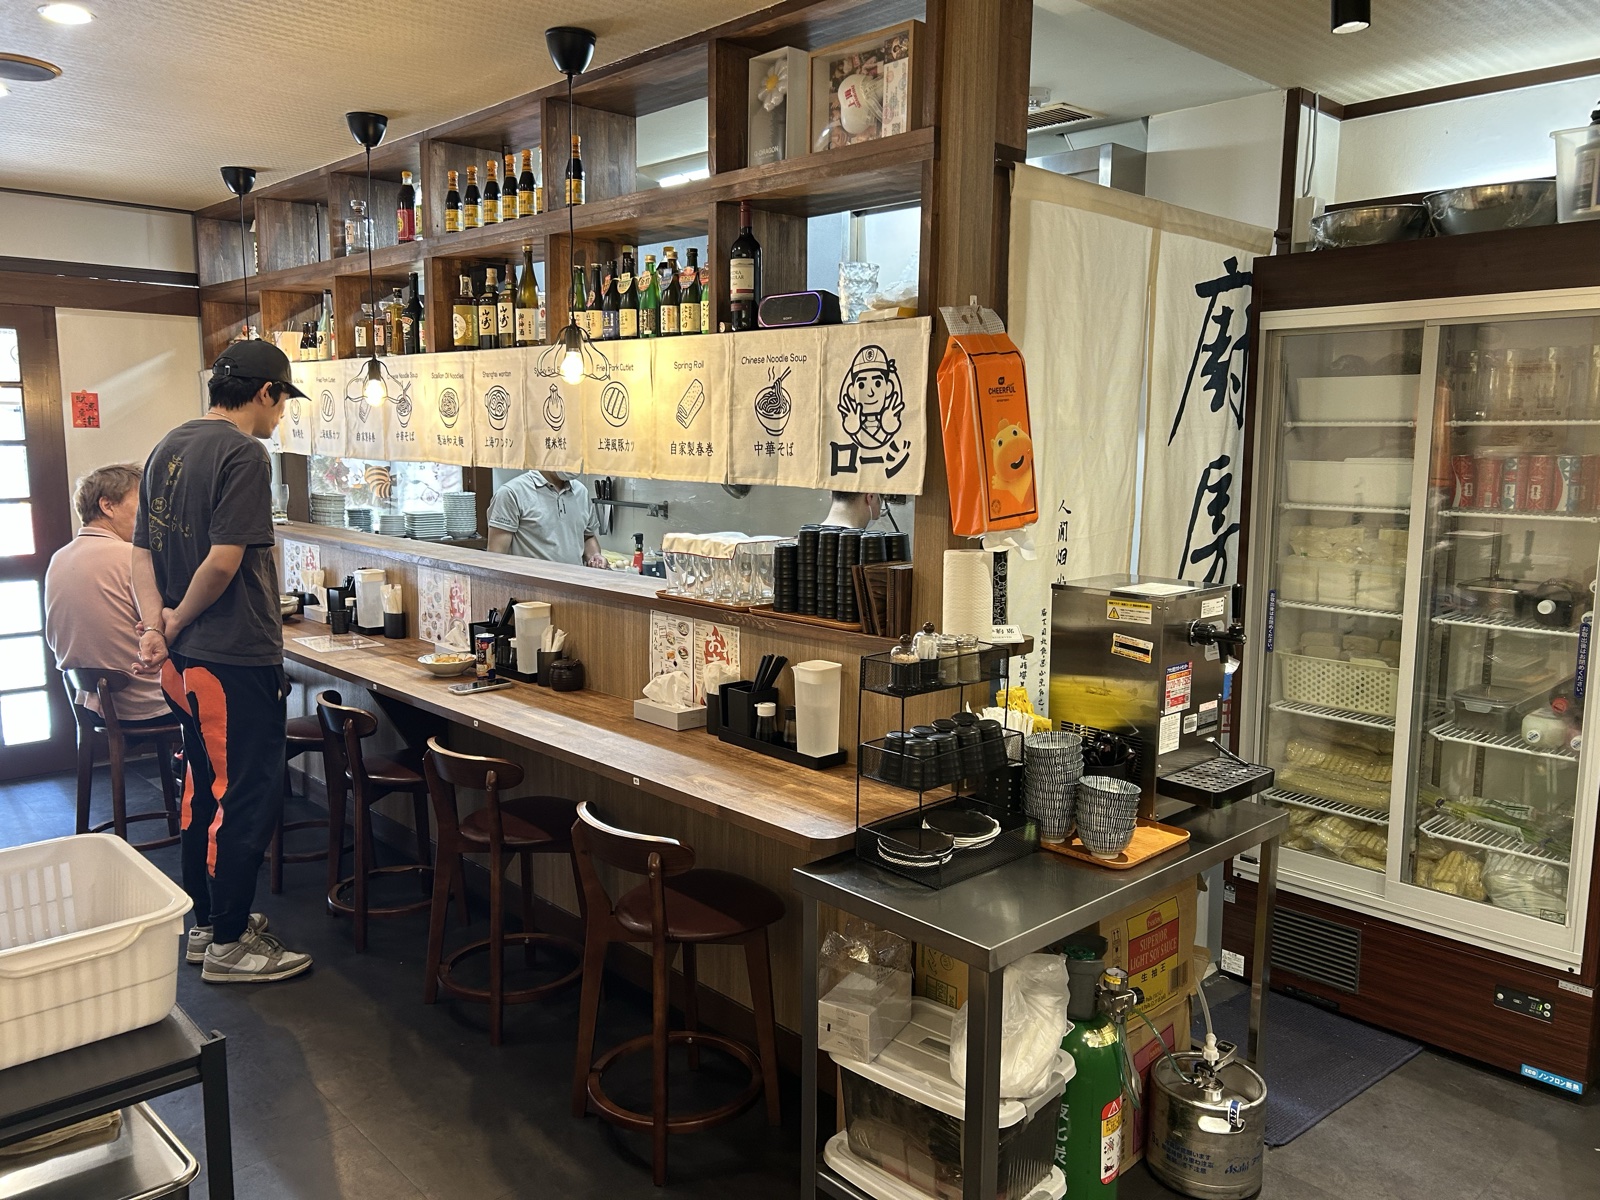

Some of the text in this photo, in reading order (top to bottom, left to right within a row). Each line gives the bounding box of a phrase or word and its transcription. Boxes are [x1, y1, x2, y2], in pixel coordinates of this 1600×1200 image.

[673, 360, 705, 371] Spring Roll
[741, 352, 807, 365] Chinese Noodle Soup
[987, 384, 1017, 396] CHEERFUL
[670, 441, 714, 457] 自家製春巻
[753, 441, 794, 457] 中華そば
[829, 440, 912, 479] ロージ
[1139, 928, 1168, 952] SUPERIOR
[1130, 937, 1177, 971] LIGHT SOY SAUCE
[1538, 1071, 1580, 1091] ノンフロン断熱
[1224, 1160, 1250, 1175] Asahi
